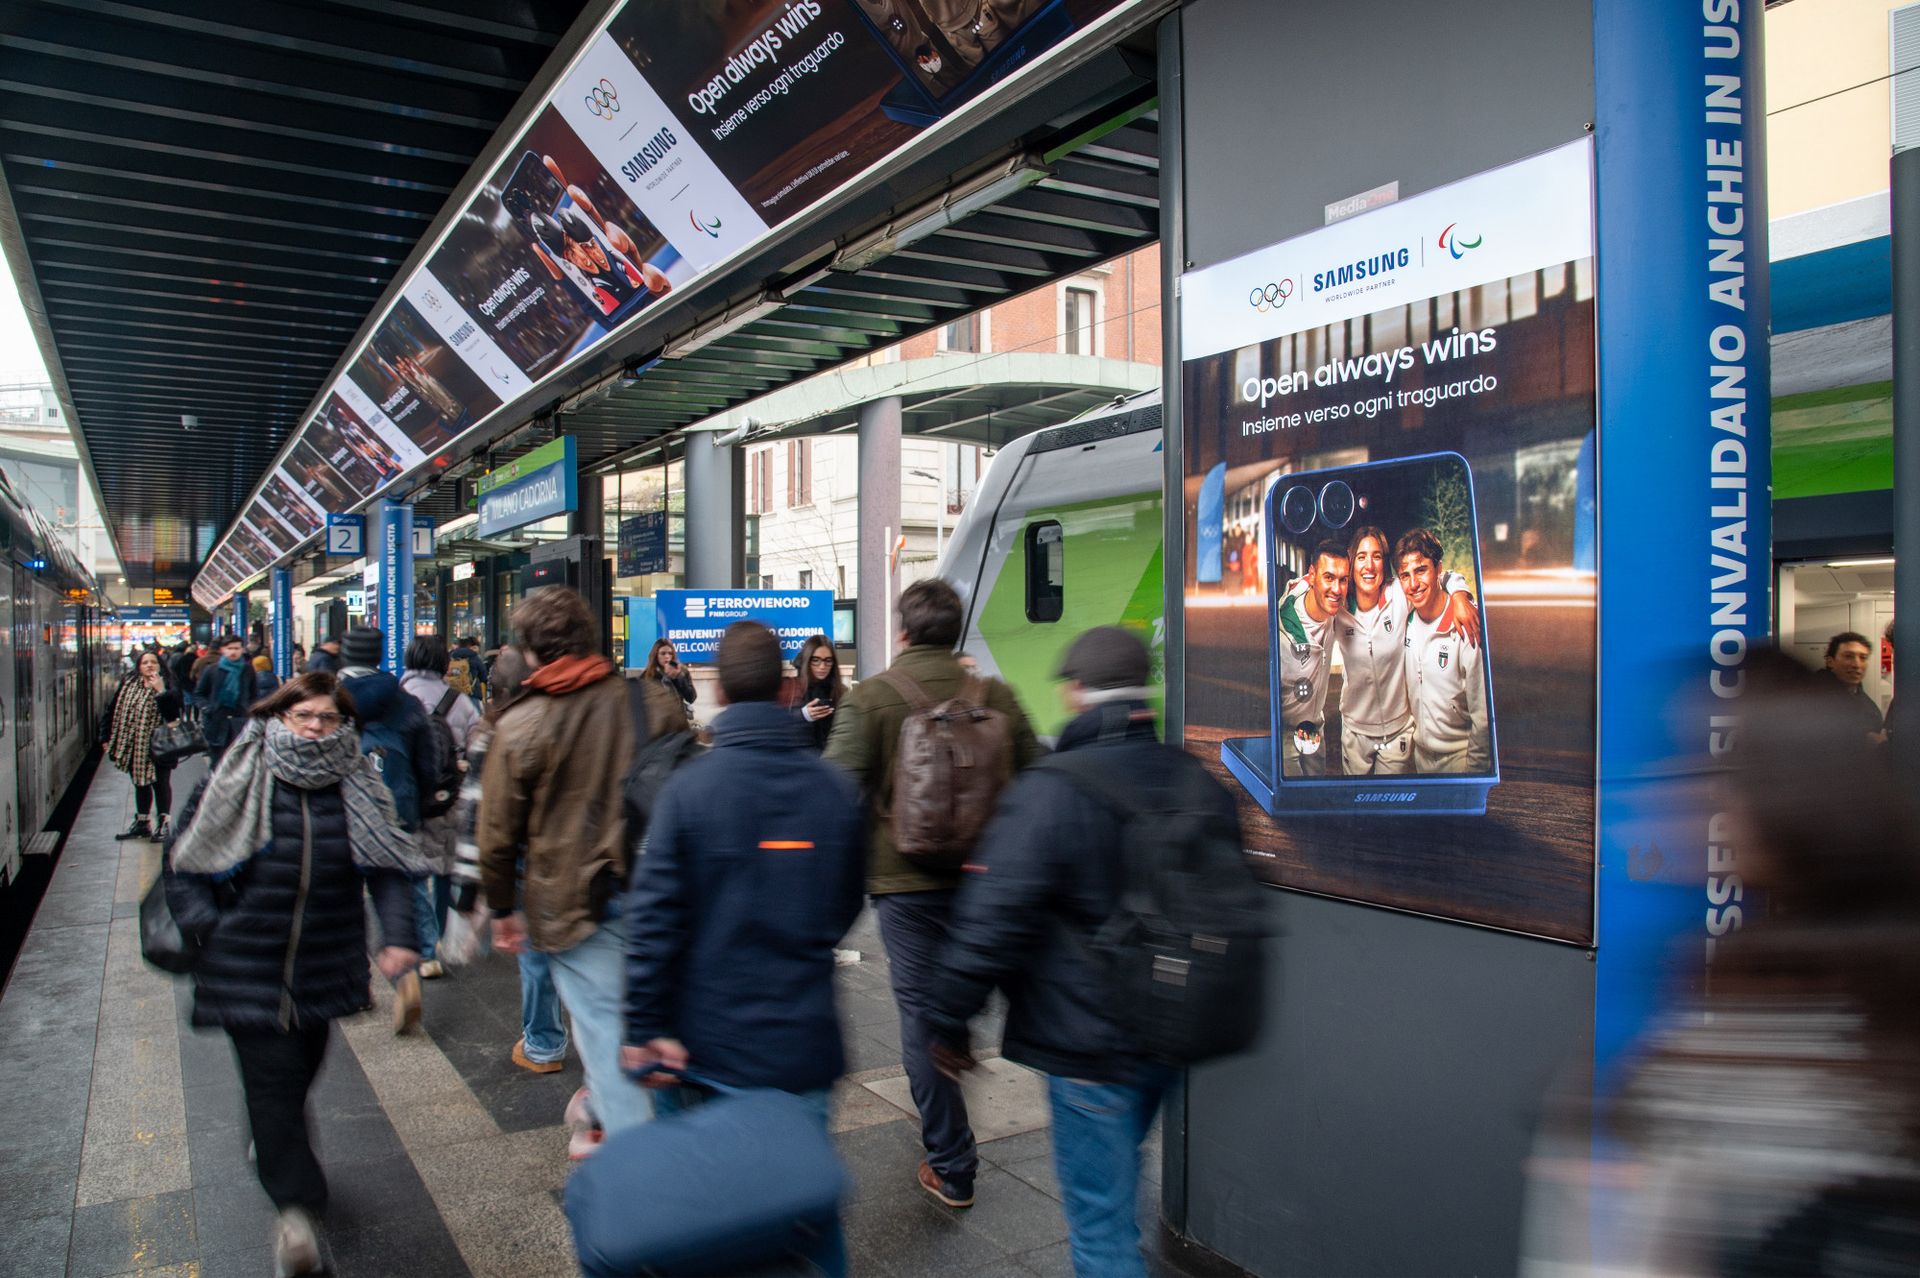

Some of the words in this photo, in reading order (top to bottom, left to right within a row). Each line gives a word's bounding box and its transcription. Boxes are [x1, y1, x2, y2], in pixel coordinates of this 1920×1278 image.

[688, 74, 731, 115] Open
[725, 29, 782, 84] always
[775, 0, 821, 40] wins
[711, 107, 748, 141] Insieme
[743, 89, 772, 114] verso
[769, 68, 795, 95] ogni
[789, 31, 845, 79] traguardo
[1704, 74, 1742, 125] IN
[621, 126, 677, 183] SAMSUNG
[1706, 138, 1746, 312] ANCHE
[1313, 247, 1409, 292] SAMSUNG
[1325, 287, 1364, 303] WORLDWIDE
[1366, 279, 1396, 292] PARTNER
[1242, 371, 1308, 408] Open
[1314, 346, 1415, 383] always
[1421, 326, 1497, 364] wins
[1242, 412, 1301, 437] Insieme
[1305, 403, 1351, 425] verso
[1354, 391, 1393, 418] ogni
[1397, 374, 1498, 408] traguardo
[492, 492, 518, 520] MILANO
[520, 476, 558, 511] CADORNA
[1709, 324, 1748, 699] CONVALIDANO
[338, 529, 352, 550] 2
[387, 523, 396, 555] USCITA
[412, 531, 420, 551] 1
[387, 555, 396, 565] IN
[388, 566, 397, 595] ANCHE
[402, 594, 410, 609] exit
[708, 597, 811, 609] FERROVIENORD
[388, 596, 397, 659] CONVALIDANO
[778, 626, 825, 637] CADORNA
[388, 660, 397, 669] SI
[1354, 792, 1417, 803] SAMSUNG
